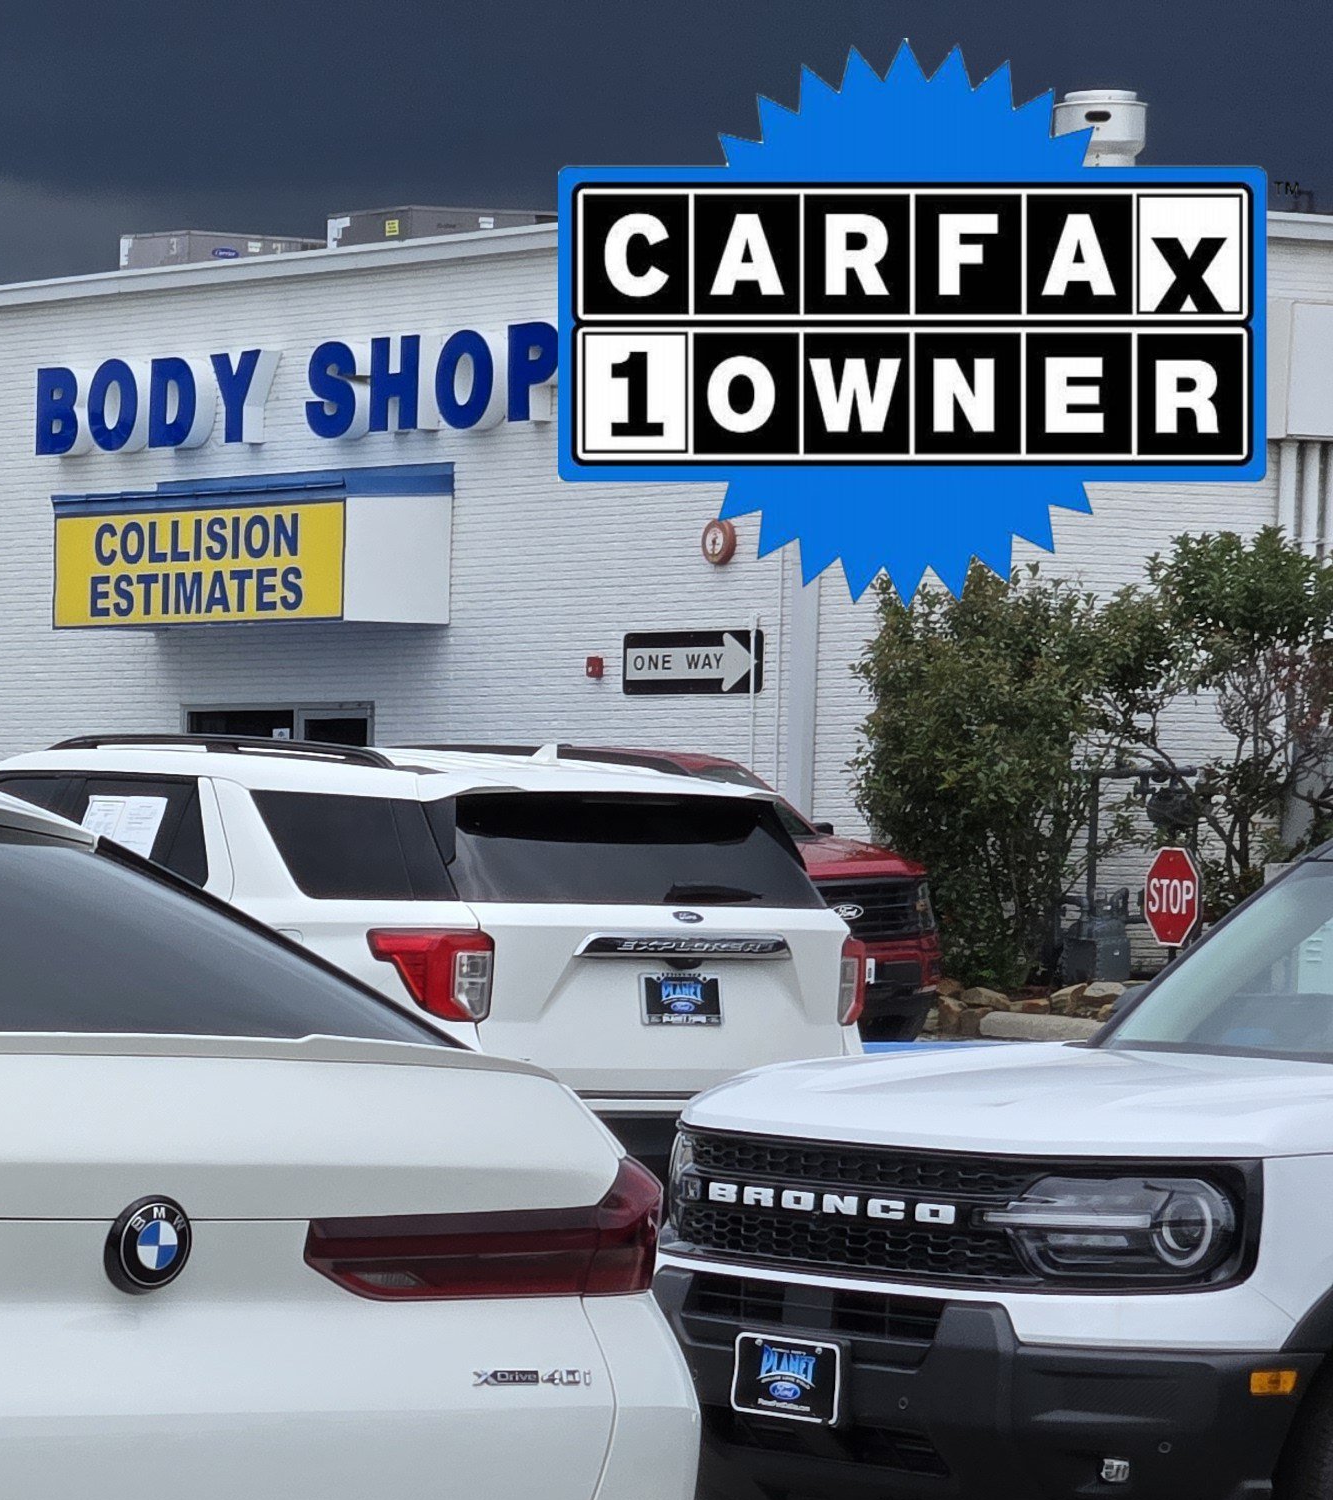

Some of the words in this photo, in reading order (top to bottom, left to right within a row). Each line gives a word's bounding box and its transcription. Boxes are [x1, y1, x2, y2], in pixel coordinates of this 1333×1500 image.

[35, 349, 263, 456] BODY
[305, 321, 559, 439] SHOP
[95, 513, 299, 566] COLLISION
[90, 566, 303, 618] ESTIMATES
[633, 654, 672, 671] ONE
[686, 652, 724, 670] WAY
[1148, 877, 1195, 915] STOP
[131, 1206, 187, 1232] BMW
[708, 1181, 956, 1225] BRONCO
[760, 1344, 817, 1384] PLANET
